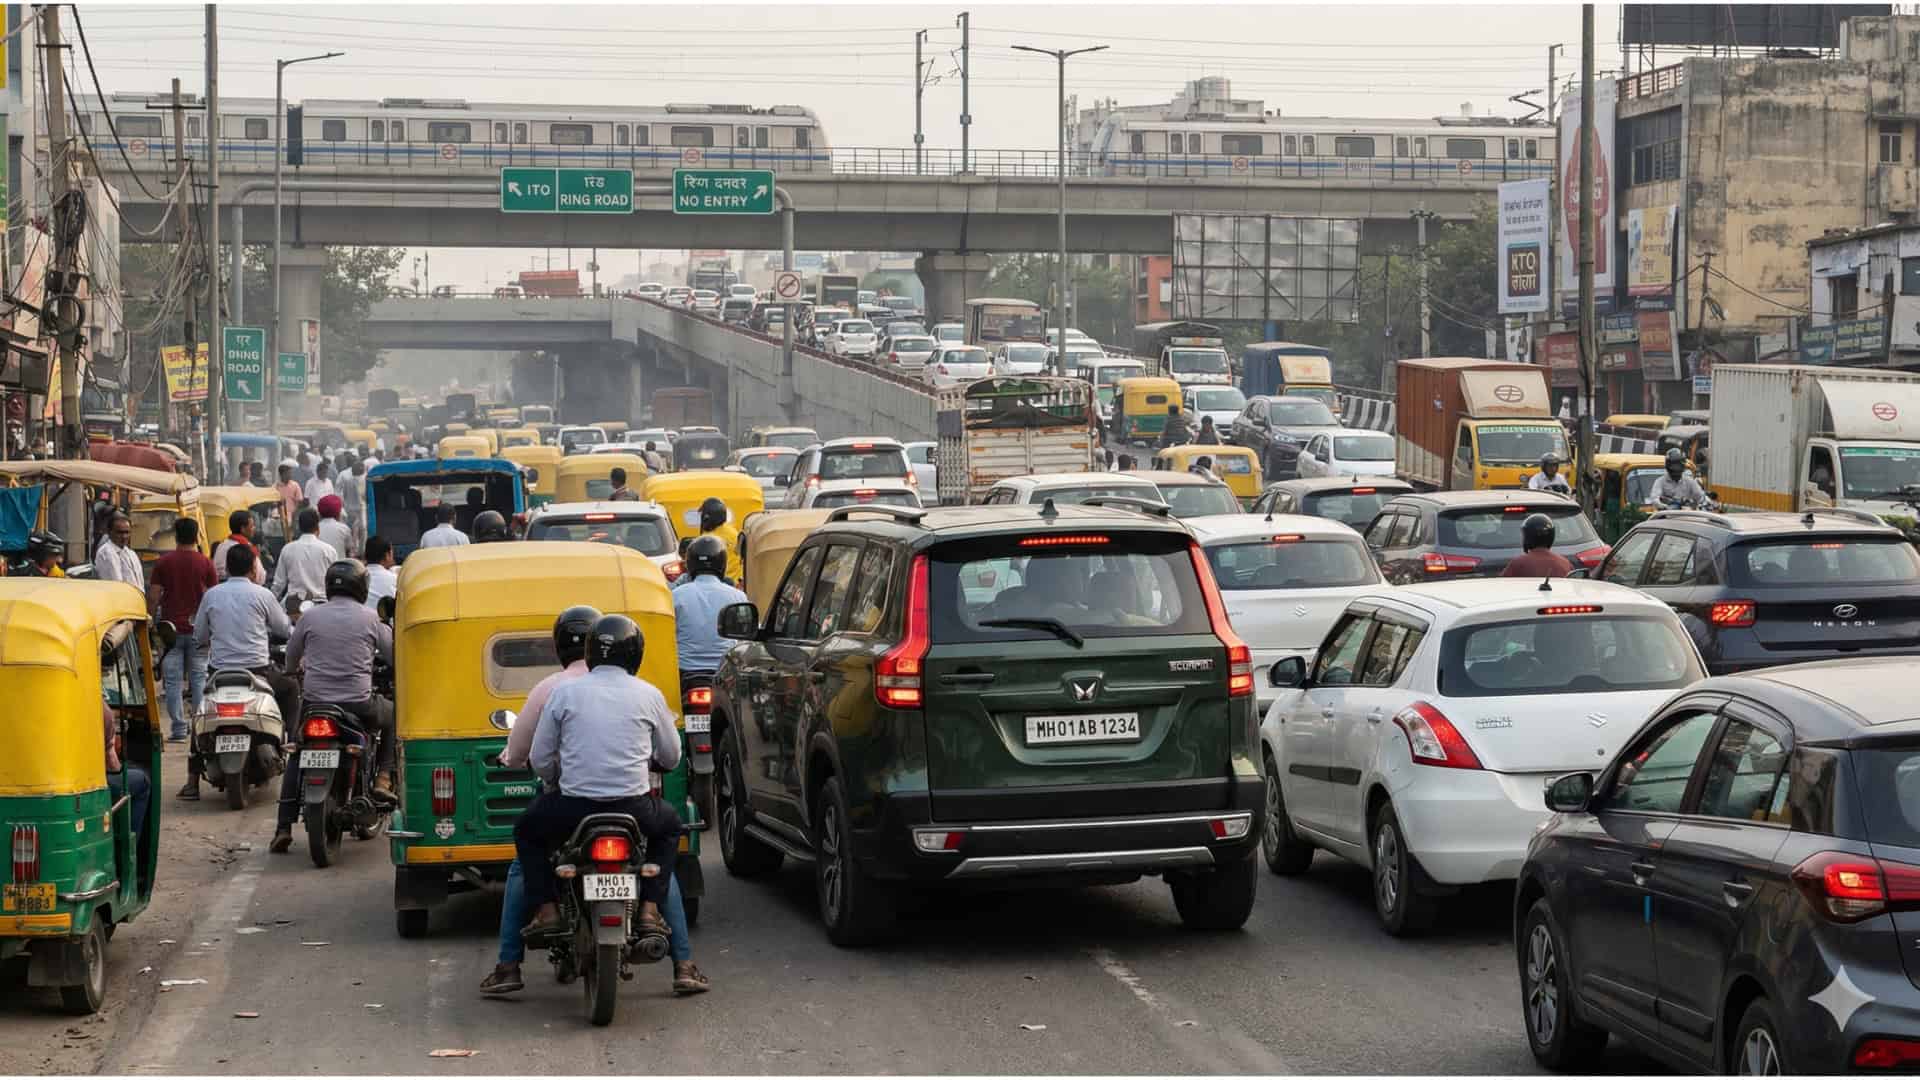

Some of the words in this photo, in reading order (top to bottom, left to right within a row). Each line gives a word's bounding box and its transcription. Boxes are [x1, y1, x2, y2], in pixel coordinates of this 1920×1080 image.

[527, 184, 550, 196] ITO
[560, 194, 590, 206] RING
[593, 194, 628, 206] ROAD
[679, 195, 699, 207] NO
[703, 195, 748, 207] ENTRY
[227, 363, 260, 374] ROAD
